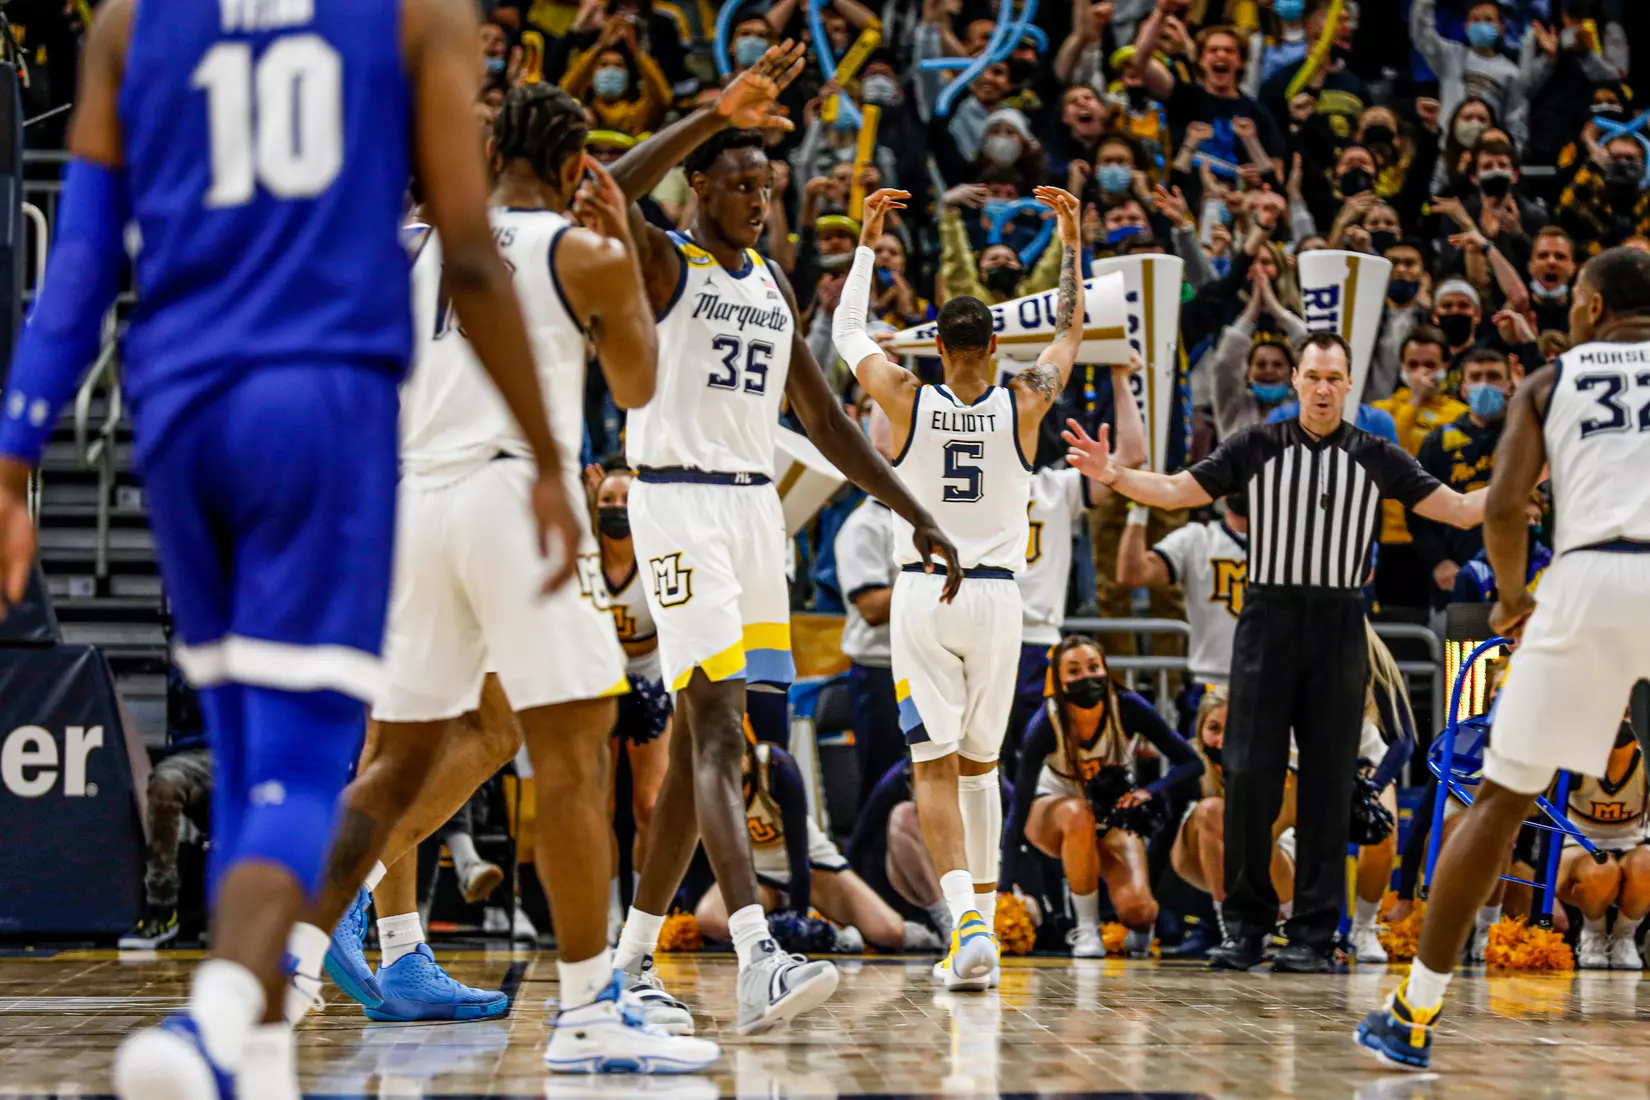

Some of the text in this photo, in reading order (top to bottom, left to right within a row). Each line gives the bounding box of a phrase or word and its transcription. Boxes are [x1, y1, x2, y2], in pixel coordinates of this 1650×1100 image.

[191, 34, 344, 208] 10
[692, 292, 788, 332] Marquette
[707, 333, 775, 396] 35
[931, 410, 996, 433] ELLIOTT
[1574, 370, 1650, 440] 3
[942, 439, 984, 503] 5
[1, 724, 104, 798] er
